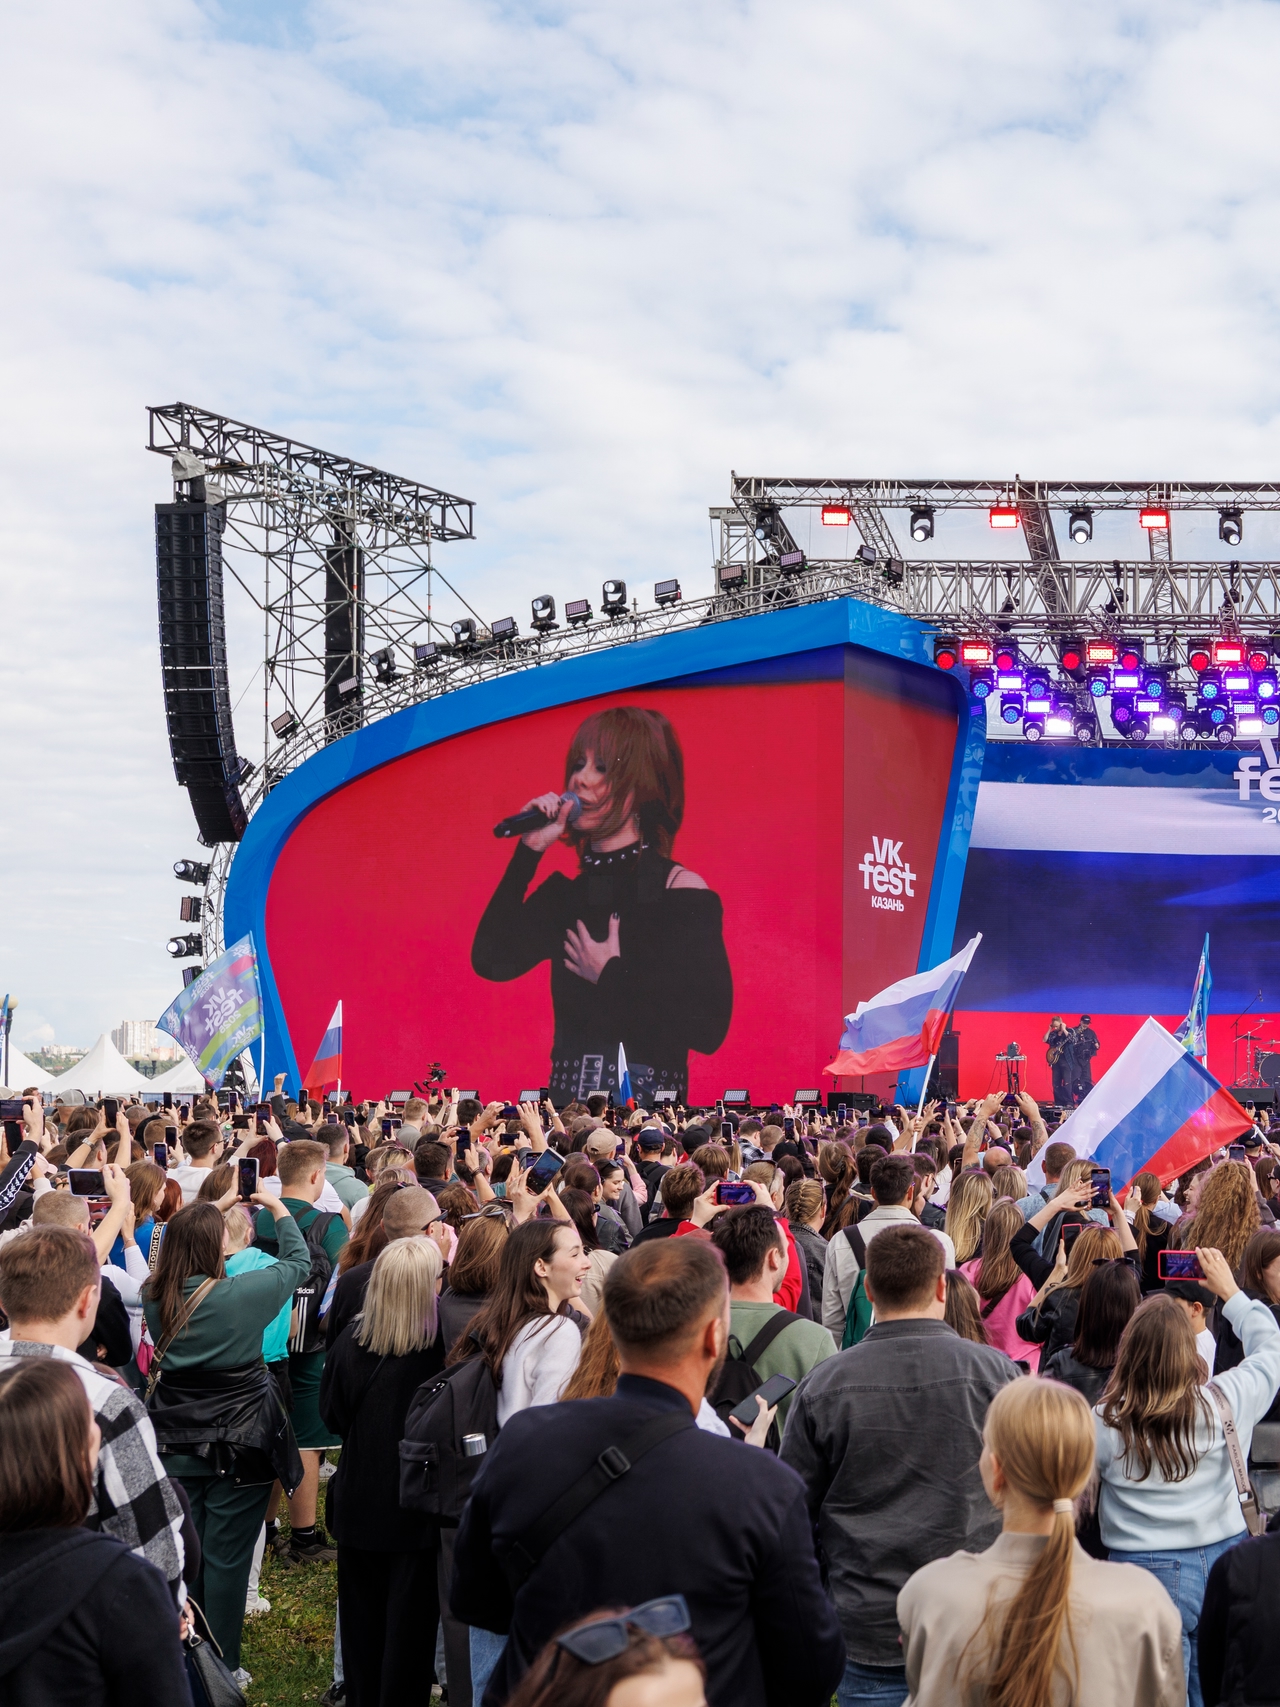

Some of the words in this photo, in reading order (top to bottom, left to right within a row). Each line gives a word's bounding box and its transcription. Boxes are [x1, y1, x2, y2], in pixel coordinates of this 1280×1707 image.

[872, 835, 904, 867] VK
[859, 852, 917, 897] fest
[871, 895, 905, 912] КАЗАНЬ
[151, 1239, 160, 1262] HUGO
